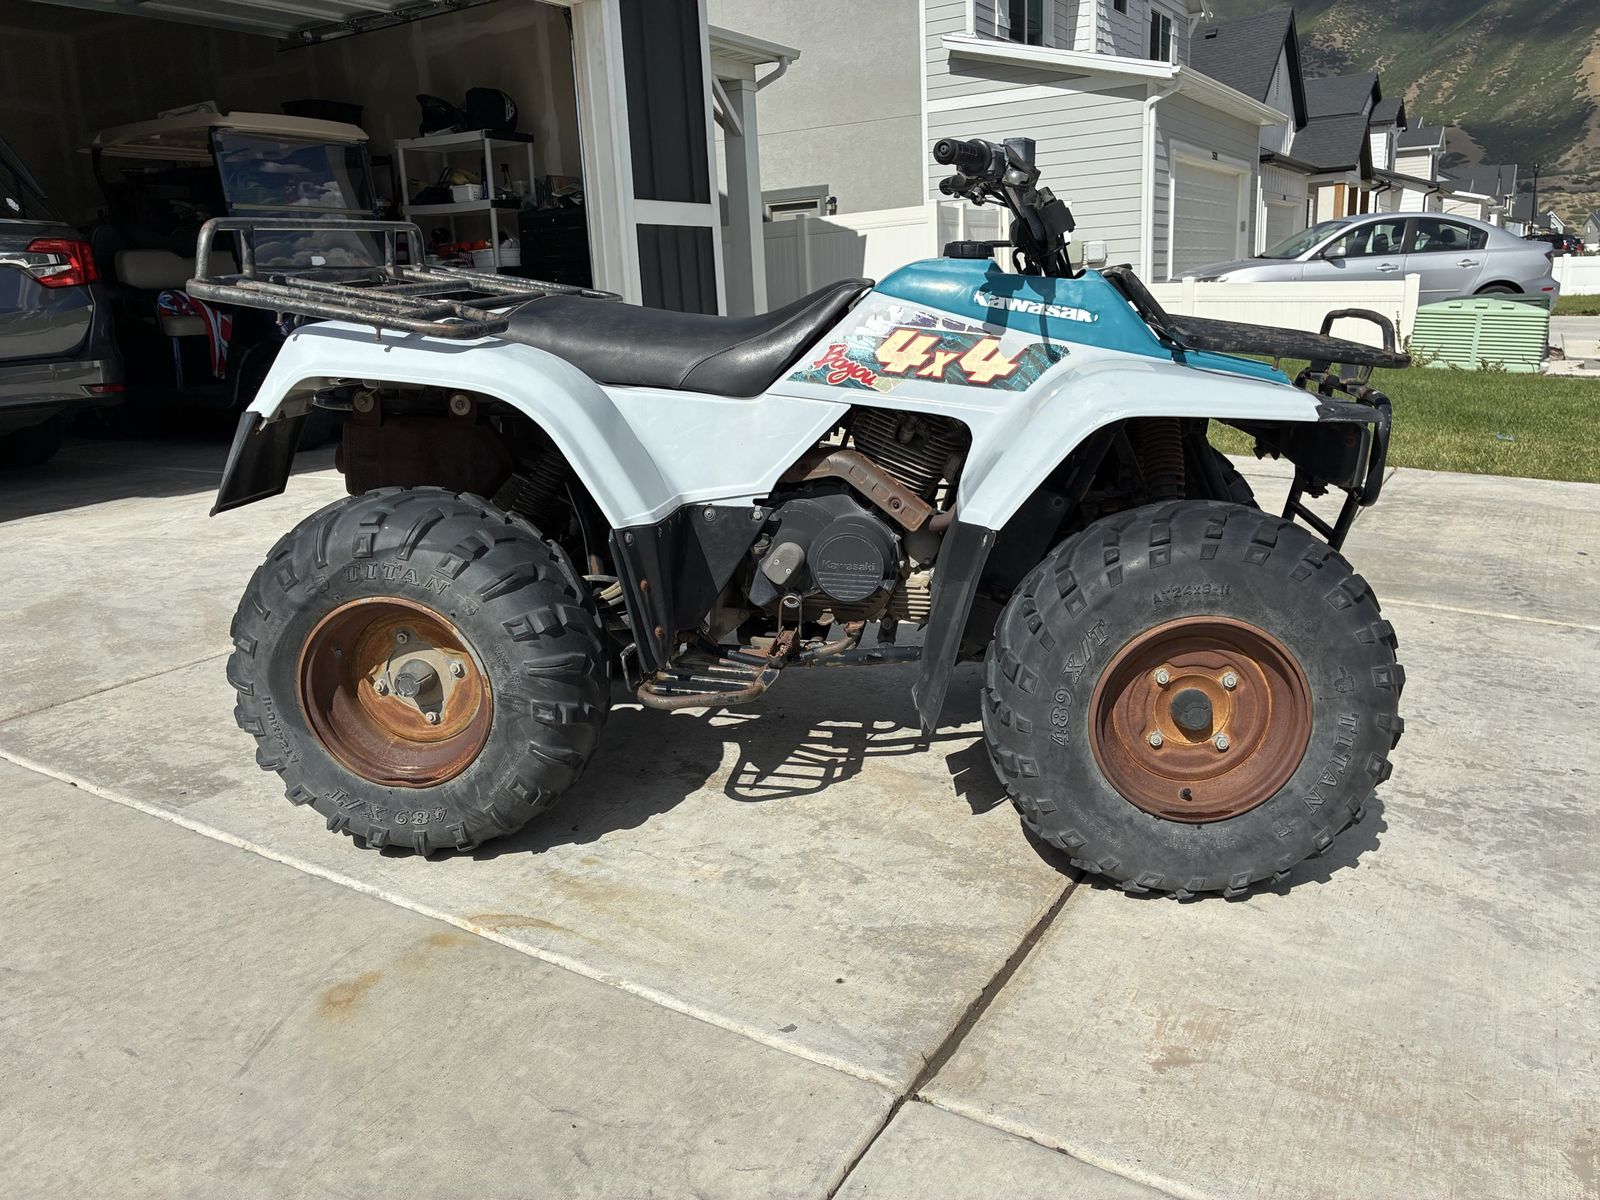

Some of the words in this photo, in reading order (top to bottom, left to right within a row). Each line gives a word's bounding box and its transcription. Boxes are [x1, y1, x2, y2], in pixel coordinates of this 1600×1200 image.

[974, 290, 1098, 323] Kawasak
[876, 328, 1028, 385] 4x4
[344, 562, 450, 595] TITAN
[822, 559, 876, 573] Kawasaki
[1050, 689, 1072, 747] 489
[1062, 619, 1111, 684] X/T
[1303, 713, 1358, 816] TITAN
[325, 787, 388, 822] X/T
[393, 807, 447, 826] 489
